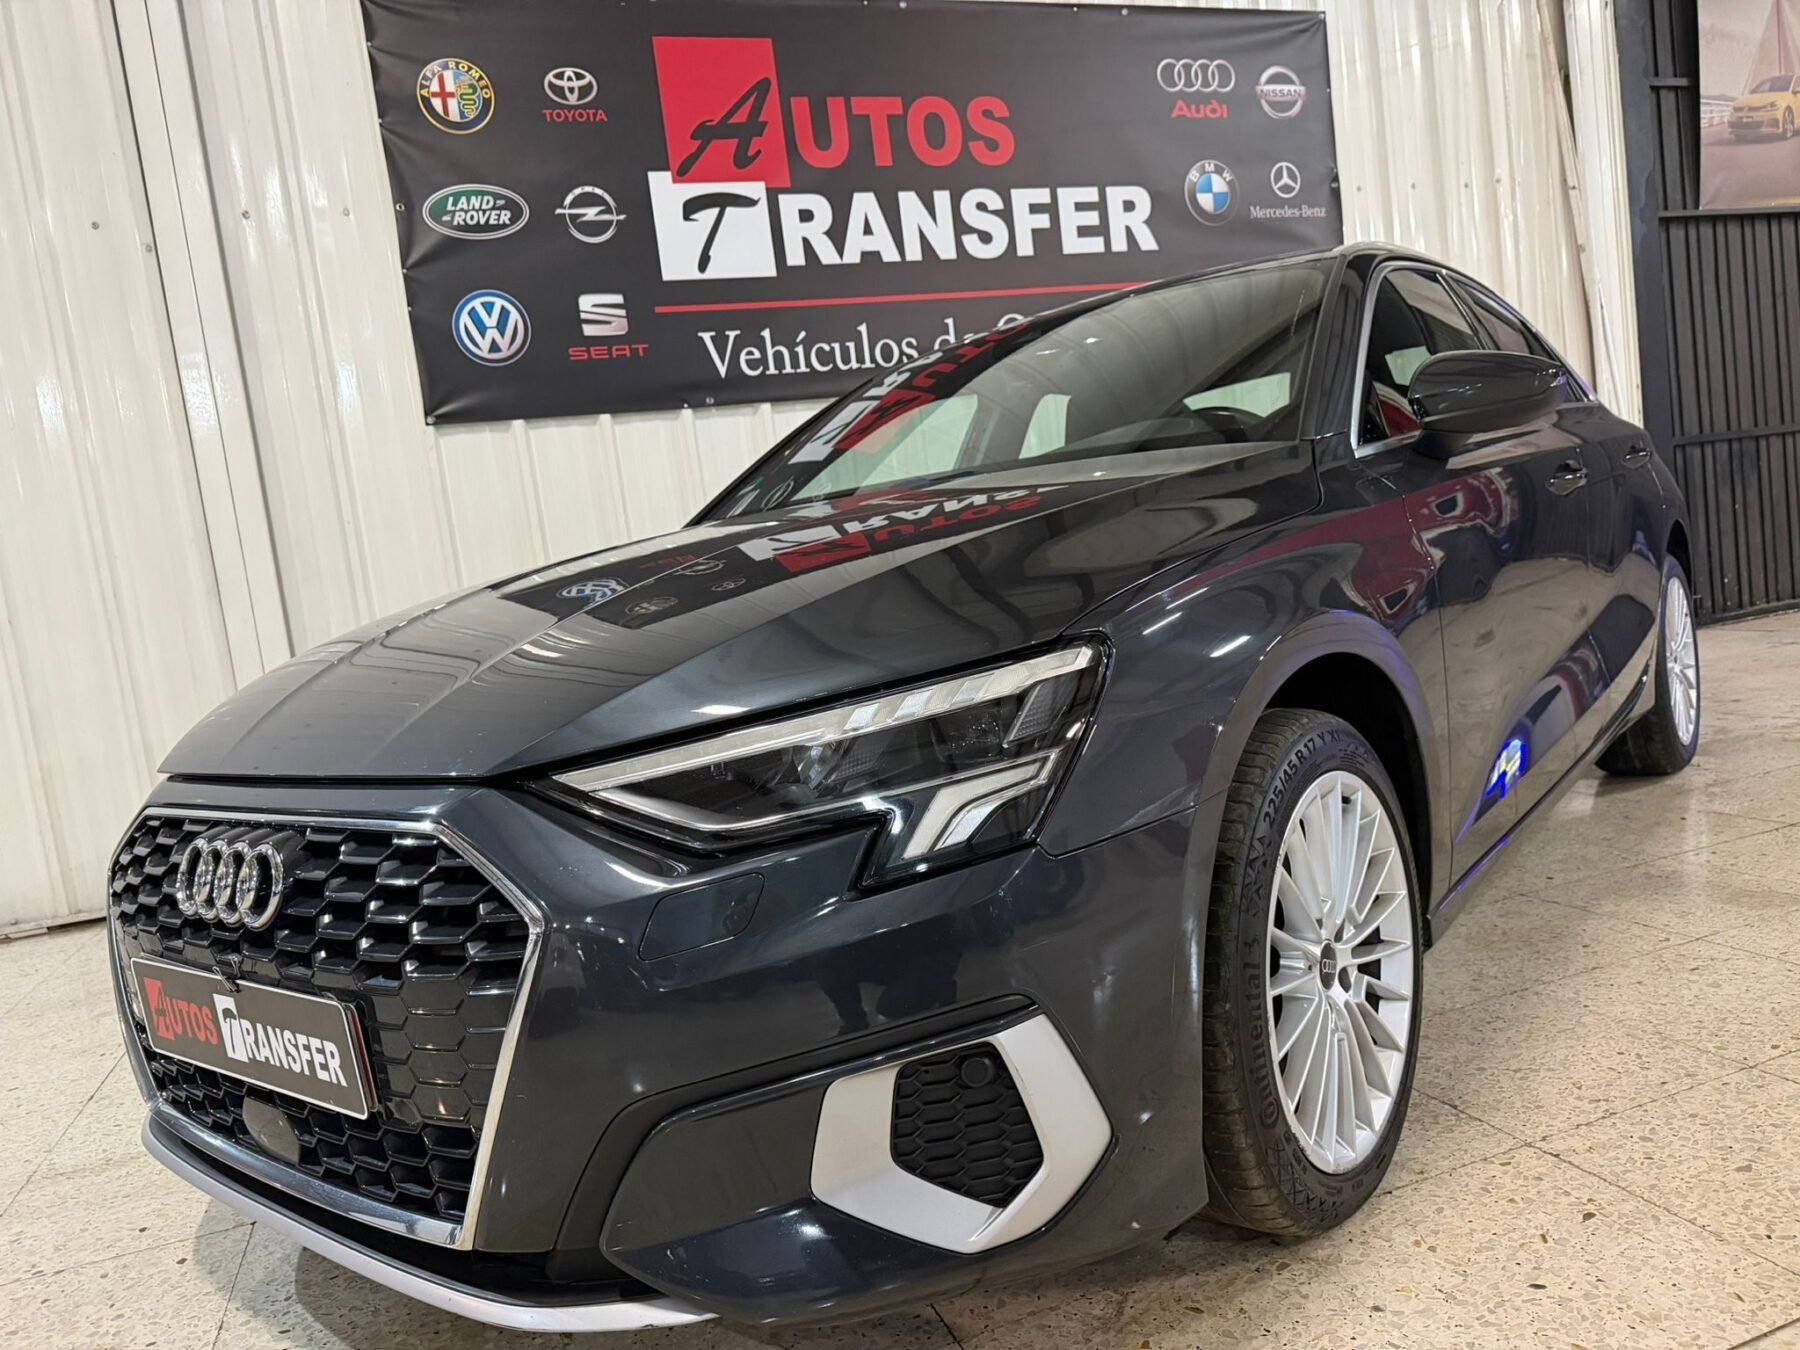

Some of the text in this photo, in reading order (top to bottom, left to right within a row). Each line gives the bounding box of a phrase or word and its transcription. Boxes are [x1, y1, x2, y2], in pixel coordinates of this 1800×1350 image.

[420, 61, 492, 99] ALFA ROMEO
[1259, 88, 1302, 98] NISSAN
[542, 109, 608, 122] TOYOTA
[1171, 100, 1229, 118] Audi
[675, 76, 1016, 179] AUTOS
[1189, 162, 1234, 183] BMW
[446, 195, 494, 211] LAND
[1250, 204, 1327, 219] Mercedes-Benz
[452, 210, 512, 226] ROVER
[682, 185, 1160, 275] TRANSFER
[568, 344, 649, 361] SEAT
[698, 321, 919, 379] Vehículos
[1262, 758, 1298, 830] 225/45
[150, 982, 348, 1088] AUTOS TRANSFER
